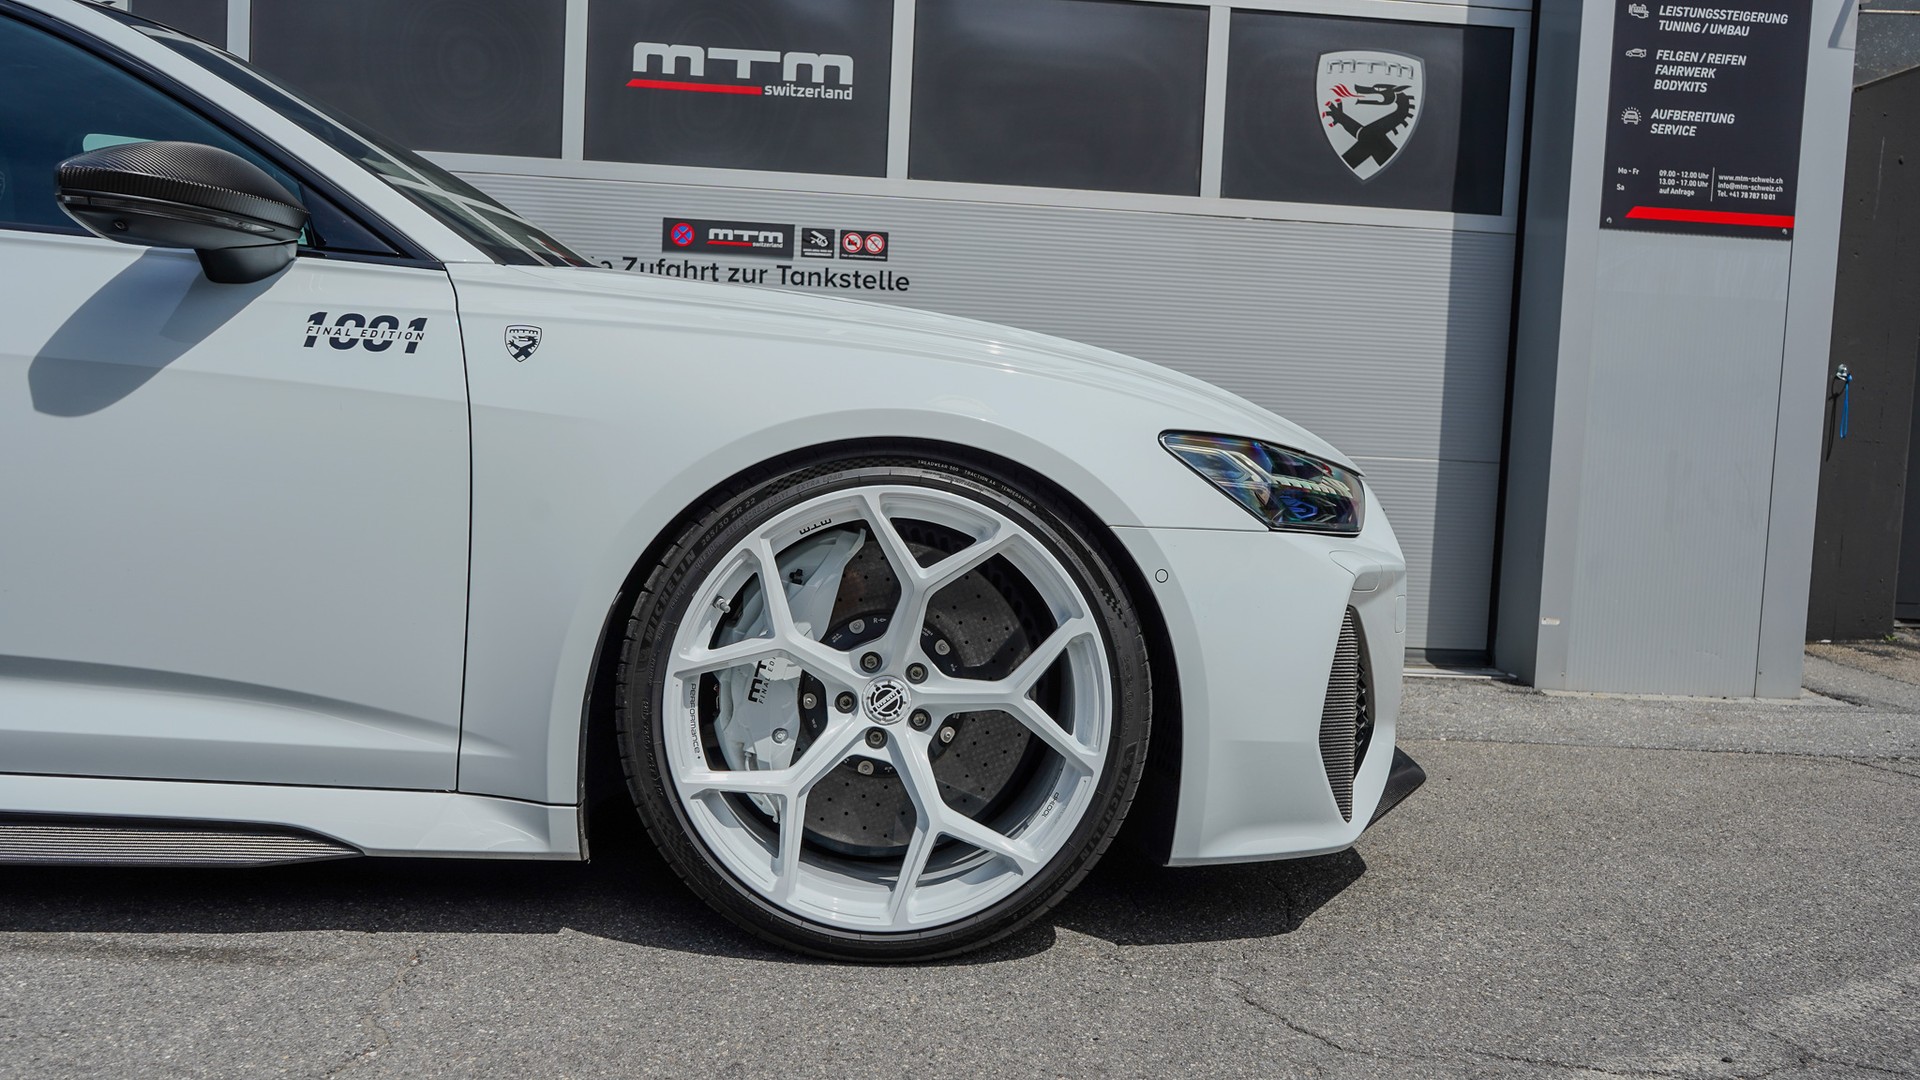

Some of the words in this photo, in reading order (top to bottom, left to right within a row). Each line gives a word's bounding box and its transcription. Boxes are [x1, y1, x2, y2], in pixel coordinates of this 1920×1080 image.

[1659, 5, 1788, 24] LEISTUNGSSTEIGERUNG
[1659, 20, 1701, 34] TUNING
[1702, 22, 1709, 34] /
[1710, 24, 1750, 37] UMBAU
[1656, 50, 1698, 63] FELGEN
[1700, 52, 1706, 64] /
[1706, 52, 1747, 66] REIFEN
[1654, 64, 1717, 79] FAHRWERK
[764, 83, 853, 100] switzerland
[1654, 79, 1708, 94] BODYKITS
[1650, 108, 1736, 125] AUFBEREITUNG
[1650, 124, 1698, 137] SERVICE
[1658, 170, 1676, 178] 09.00
[1718, 175, 1784, 184] www.mtm-schweiz.ch
[1670, 188, 1695, 197] Anfrage
[1718, 182, 1784, 192] info@mtm-schweiz.ch
[622, 256, 719, 282] Zufahrt
[728, 268, 768, 284] zur
[776, 264, 910, 292] Tankstelle
[303, 311, 428, 354] 1001
[306, 326, 352, 337] FINAL
[360, 329, 425, 342] EDITION
[701, 518, 729, 547] 285/30
[730, 506, 744, 518] ZR
[744, 497, 756, 509] 22
[645, 549, 697, 642] MICHELIN
[758, 678, 771, 704] FINAL
[1079, 773, 1129, 861] MICHELIN
